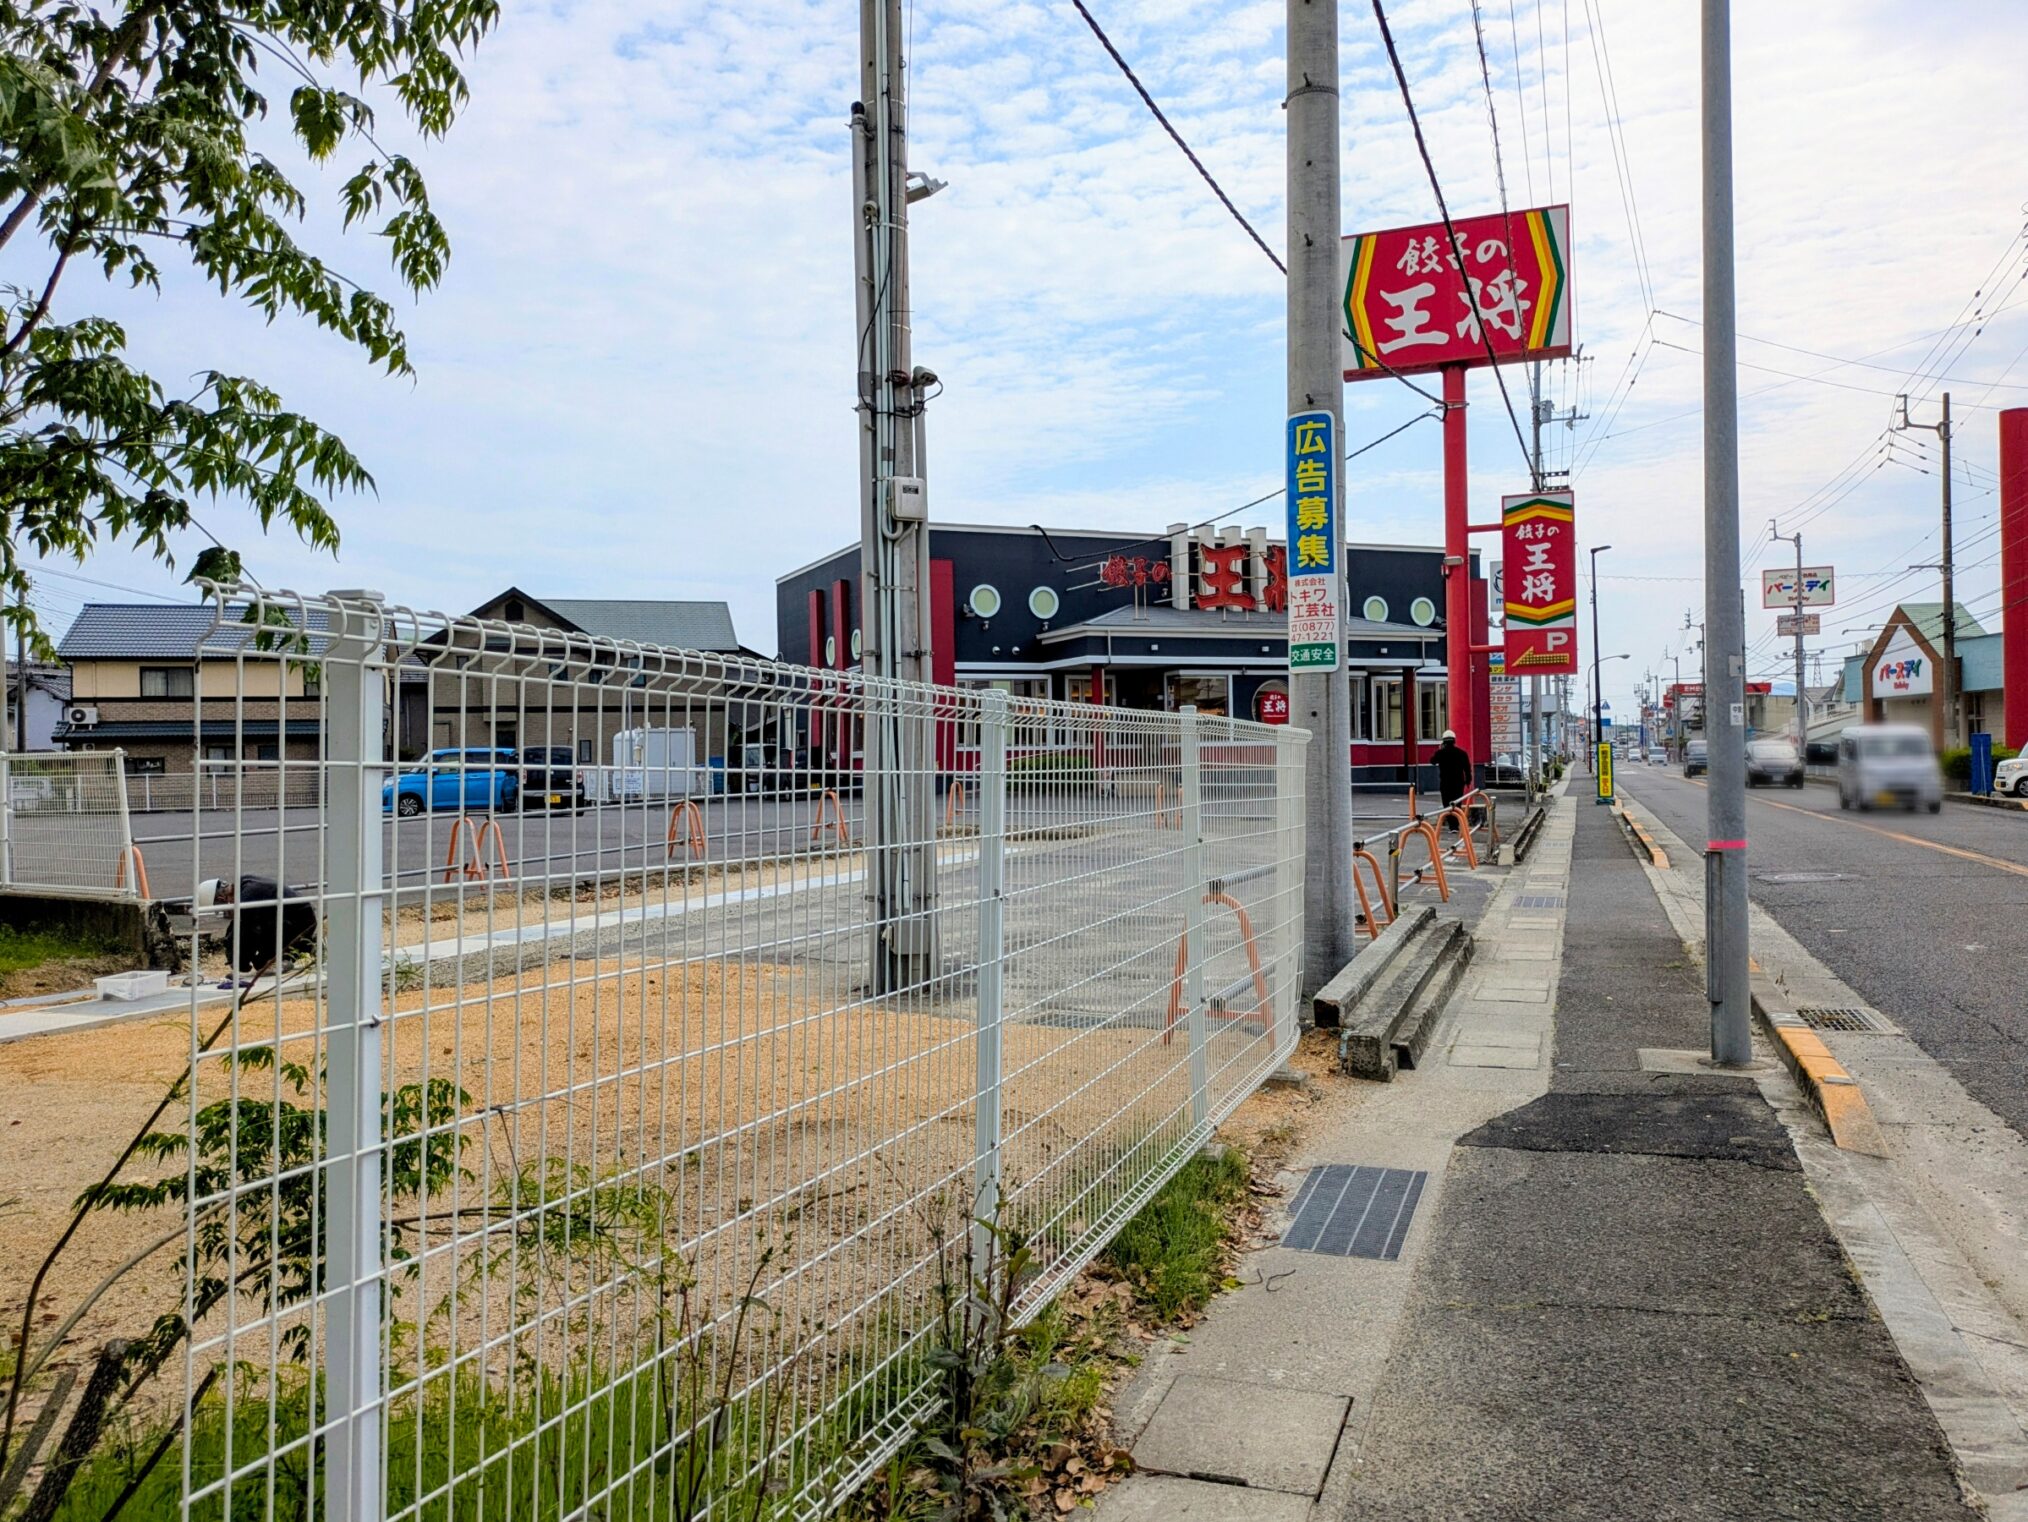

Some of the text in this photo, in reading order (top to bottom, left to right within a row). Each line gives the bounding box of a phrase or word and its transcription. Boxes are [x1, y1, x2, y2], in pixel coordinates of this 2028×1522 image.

[1397, 232, 1508, 276] 餃子の
[1377, 269, 1532, 355] 王将
[1295, 421, 1329, 568] 広告募集
[1515, 524, 1560, 540] 餃子の
[1521, 542, 1556, 603] 王将
[1294, 577, 1326, 587] 株式会社
[1290, 588, 1327, 603] トキワ
[1293, 602, 1335, 618] 工芸社
[1291, 631, 1334, 642] 47-1221
[1547, 632, 1569, 652] P
[1291, 647, 1335, 663] 交通安全
[1263, 700, 1287, 713] 王将
